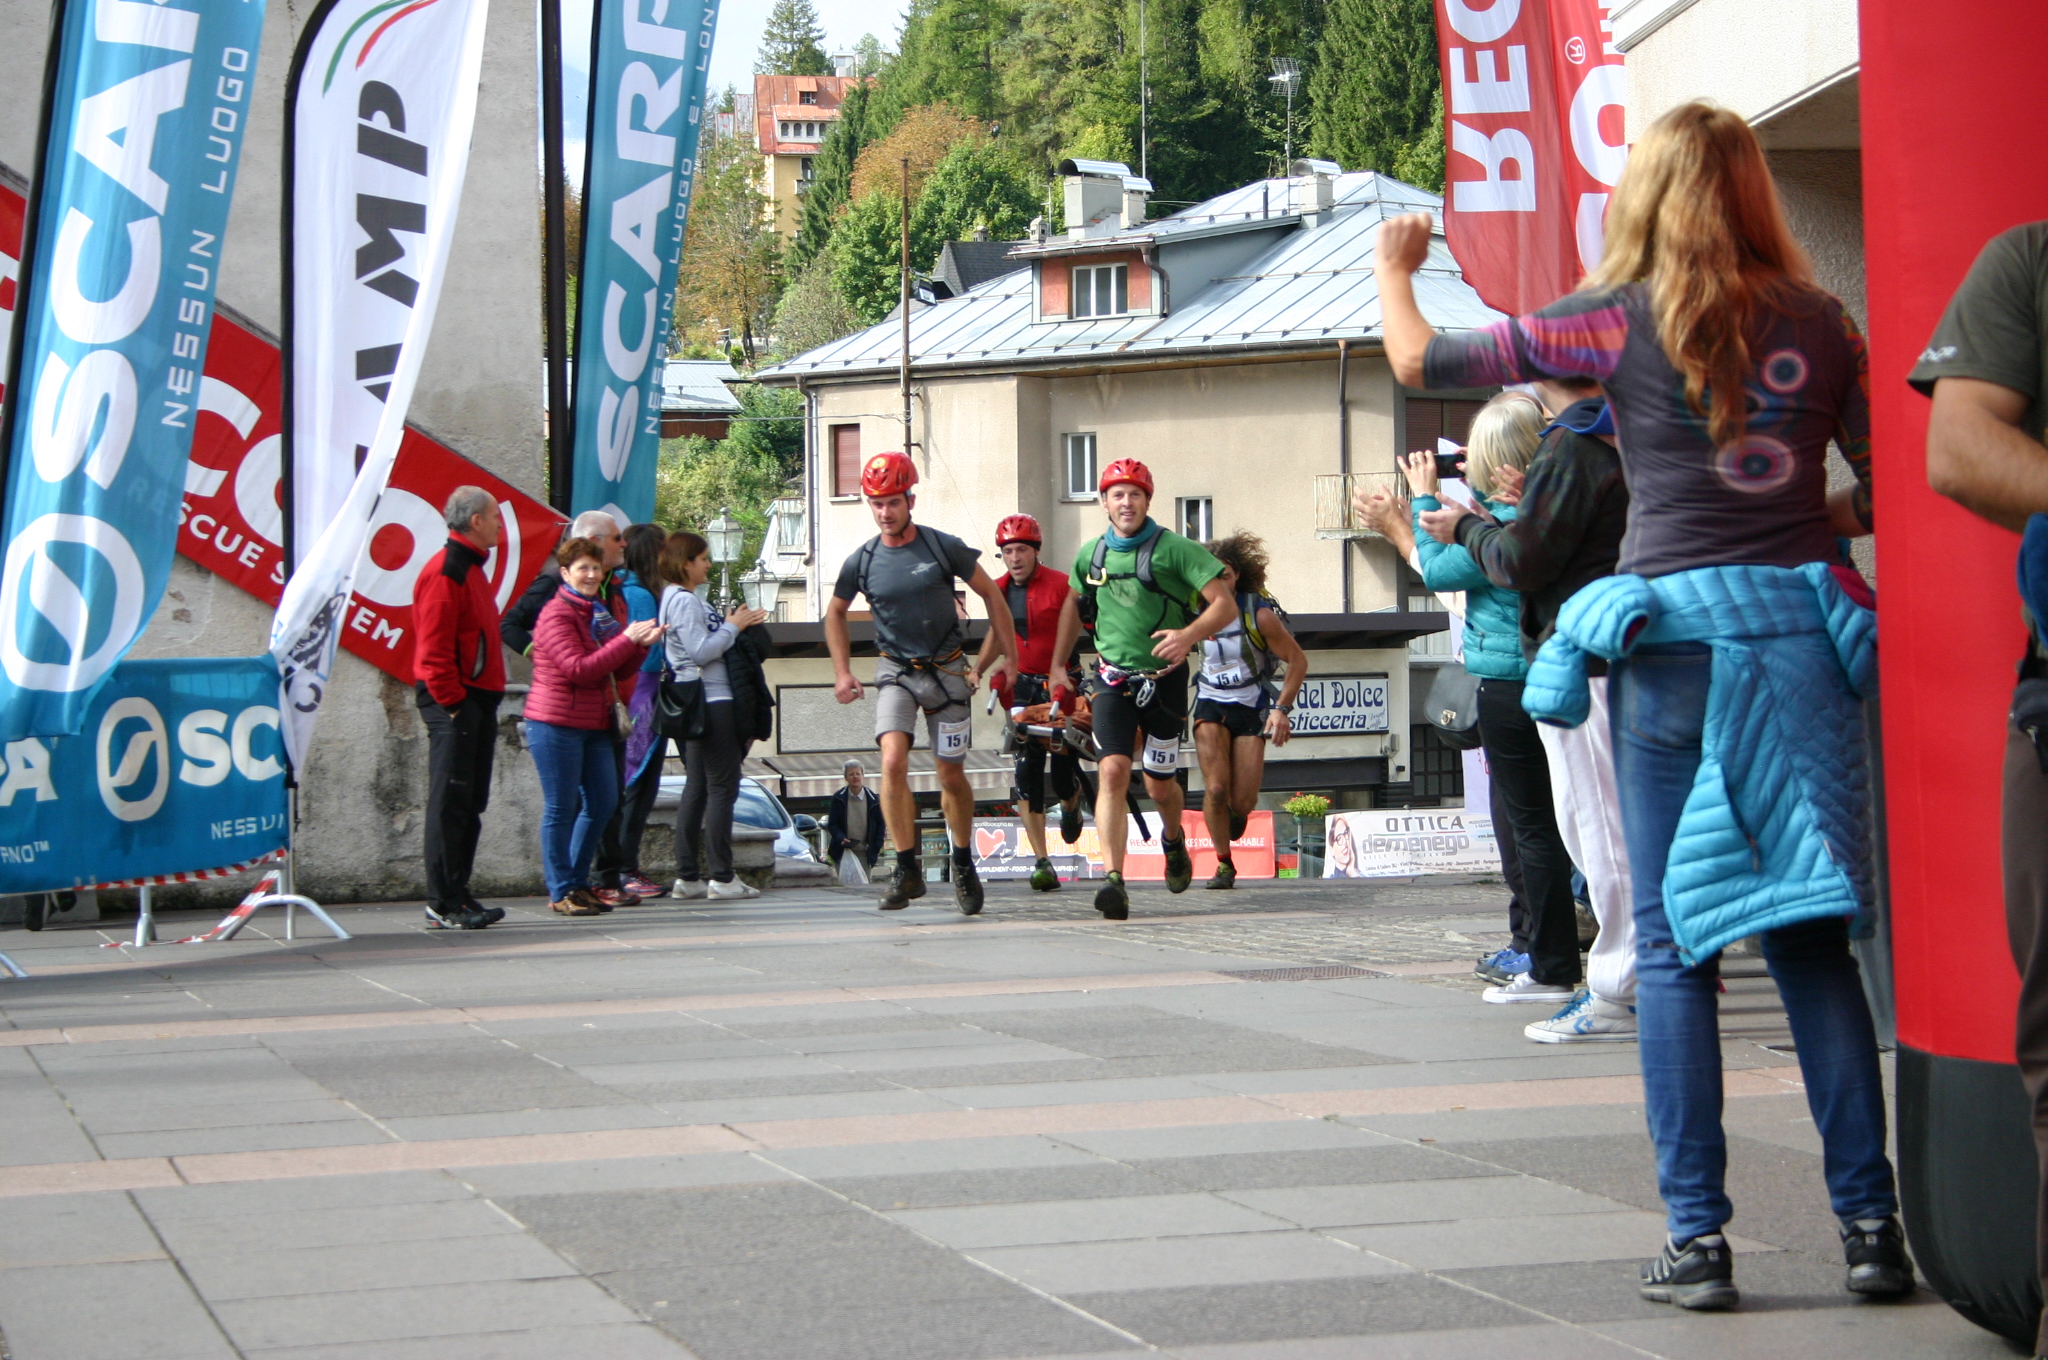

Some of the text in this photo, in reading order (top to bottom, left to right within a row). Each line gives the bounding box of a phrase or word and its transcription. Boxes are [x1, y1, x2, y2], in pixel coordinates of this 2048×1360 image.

[645, 293, 673, 434] NESSUN
[668, 158, 692, 264] LUOGO
[696, 0, 715, 71] LON
[161, 47, 249, 428] NESSUN LUOGO
[1215, 673, 1230, 686] 15
[1297, 682, 1326, 709] del
[1332, 681, 1384, 708] Dolce
[1289, 711, 1367, 731] sticceria
[946, 734, 961, 748] 15
[1151, 750, 1166, 764] 15
[1385, 815, 1465, 833] OTTICA
[1185, 838, 1198, 847] KES
[1361, 834, 1470, 856] demenego
